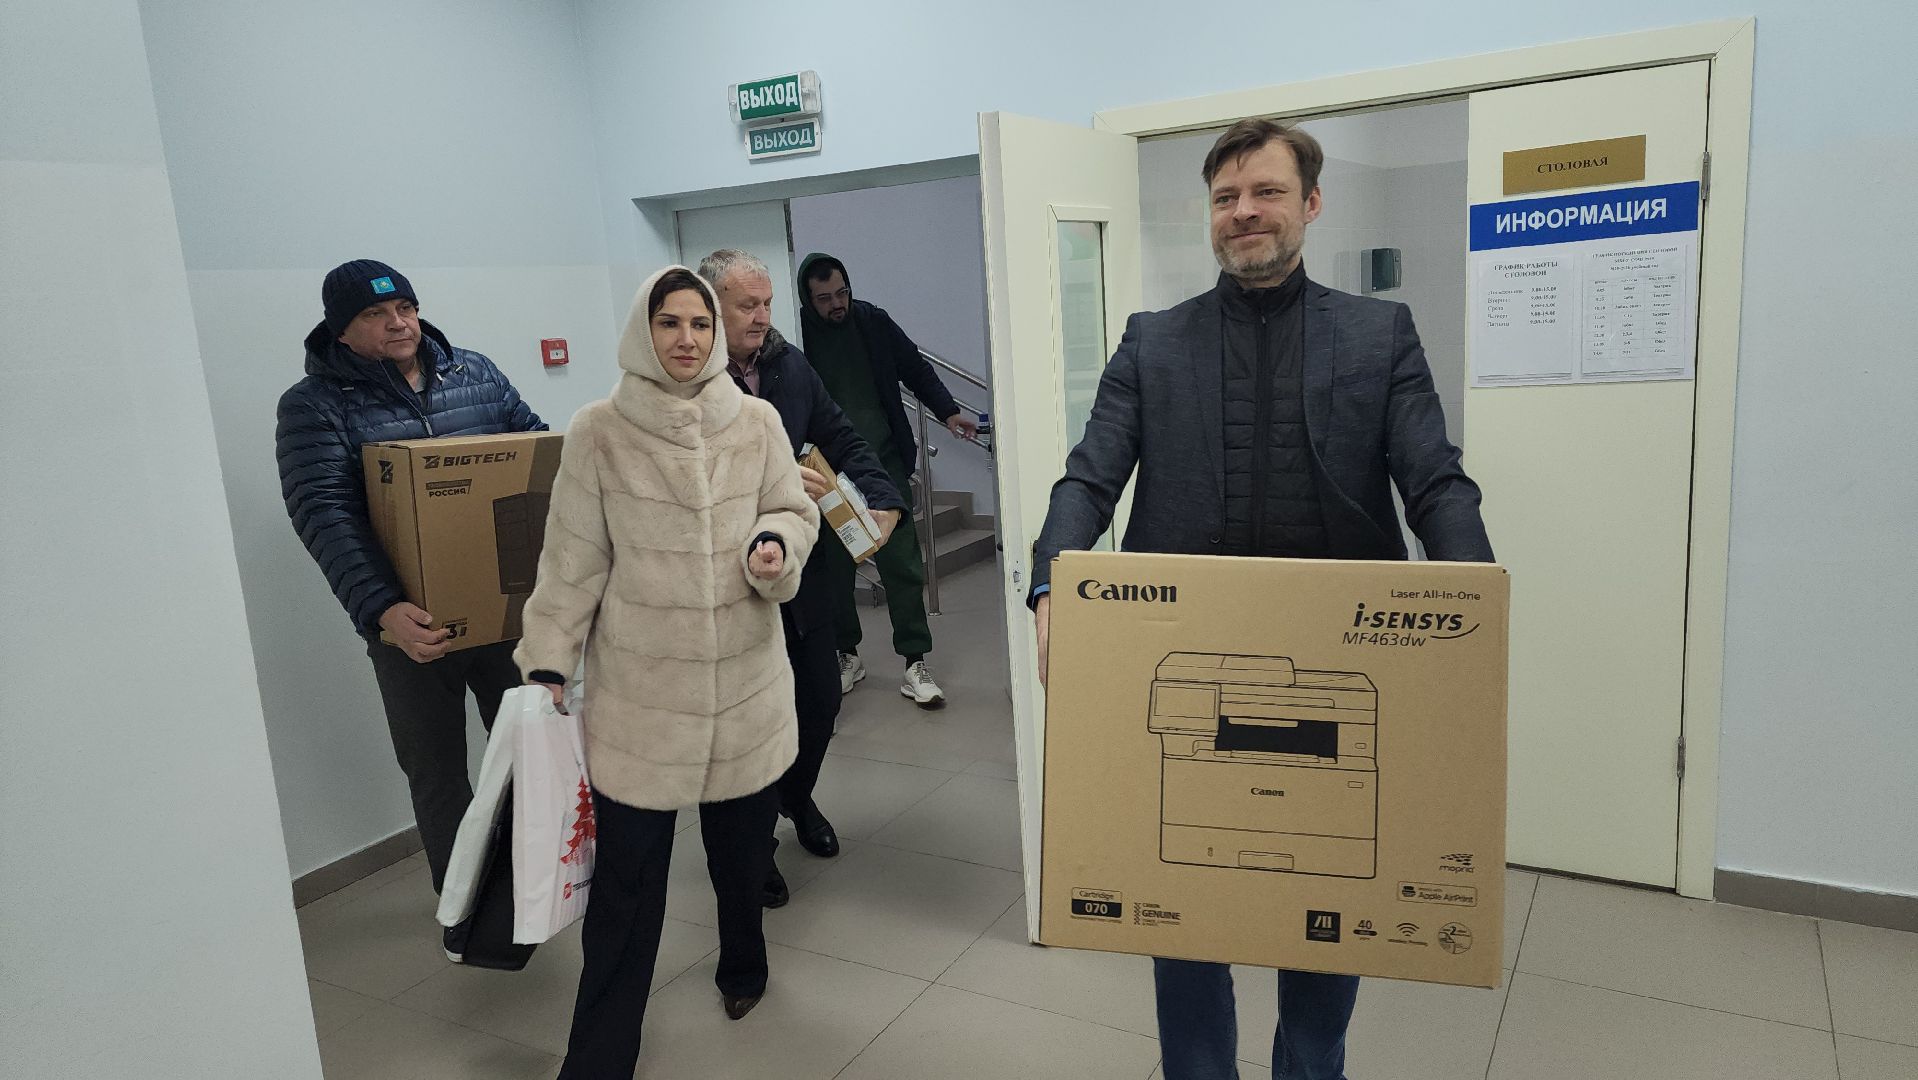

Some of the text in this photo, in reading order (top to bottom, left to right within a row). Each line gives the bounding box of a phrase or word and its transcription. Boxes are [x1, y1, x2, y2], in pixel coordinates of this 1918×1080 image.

[740, 82, 798, 110] ВЫХОД
[754, 128, 812, 150] ВЫХОД
[1537, 156, 1608, 174] СТОЛОВАЯ
[1496, 198, 1667, 233] ИНФОРМАЦИЯ
[1494, 261, 1558, 271] ГРАФИК РАБОТЫ
[443, 451, 517, 467] BIGTECH
[429, 488, 466, 498] РОССИЯ
[1077, 580, 1177, 602] Canon
[1391, 589, 1481, 601] Laser All-In-One
[1353, 603, 1464, 631] i-SENSYS
[1342, 632, 1427, 647] MF463dw
[1250, 787, 1285, 797] Canon
[1079, 890, 1115, 900] Cartridge
[1418, 892, 1442, 901] Apple
[1084, 903, 1108, 915] 070
[1142, 909, 1182, 921] GENUINE
[1358, 920, 1373, 930] 40
[1449, 925, 1457, 936] 2
